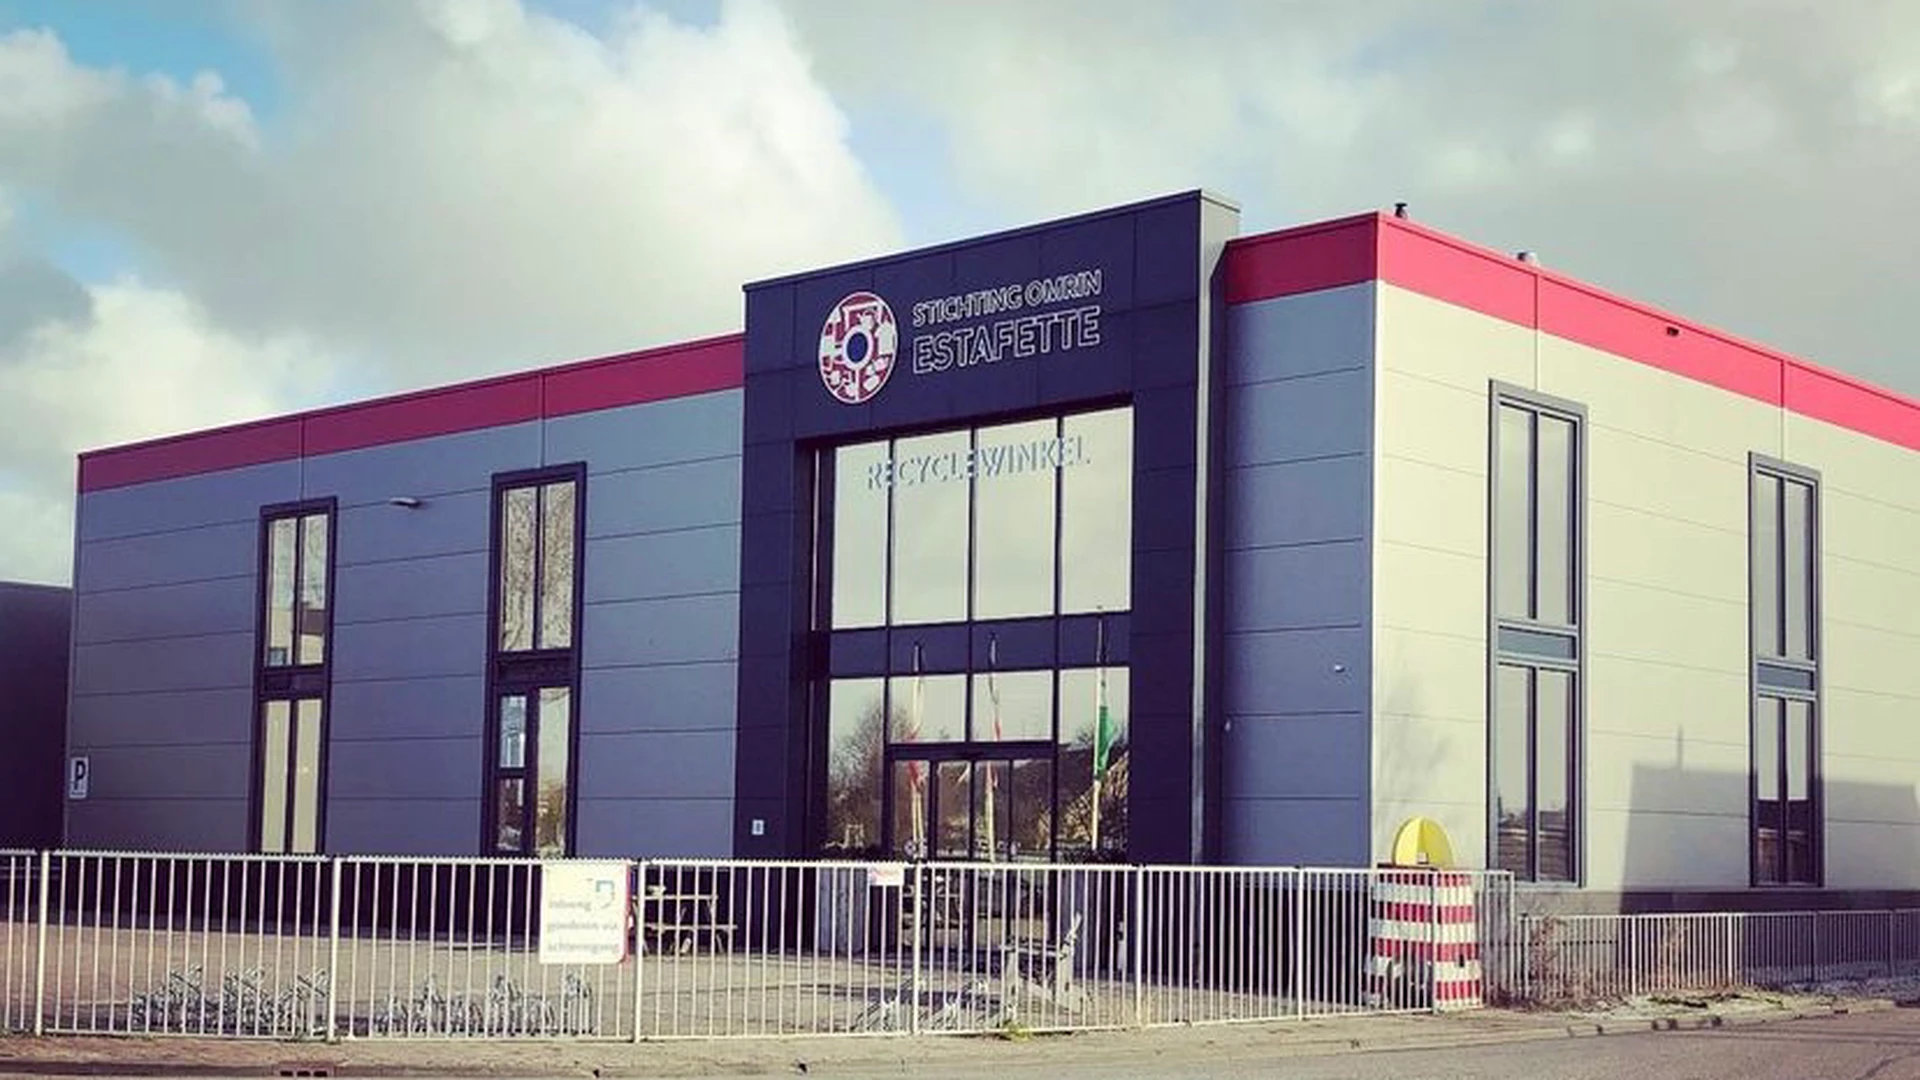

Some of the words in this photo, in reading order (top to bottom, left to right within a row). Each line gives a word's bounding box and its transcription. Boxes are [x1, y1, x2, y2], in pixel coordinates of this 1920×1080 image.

[912, 284, 1023, 328] STICHTING
[1024, 269, 1102, 307] OMRIN
[912, 304, 1101, 374] ESTAFETTE
[74, 760, 86, 790] P
